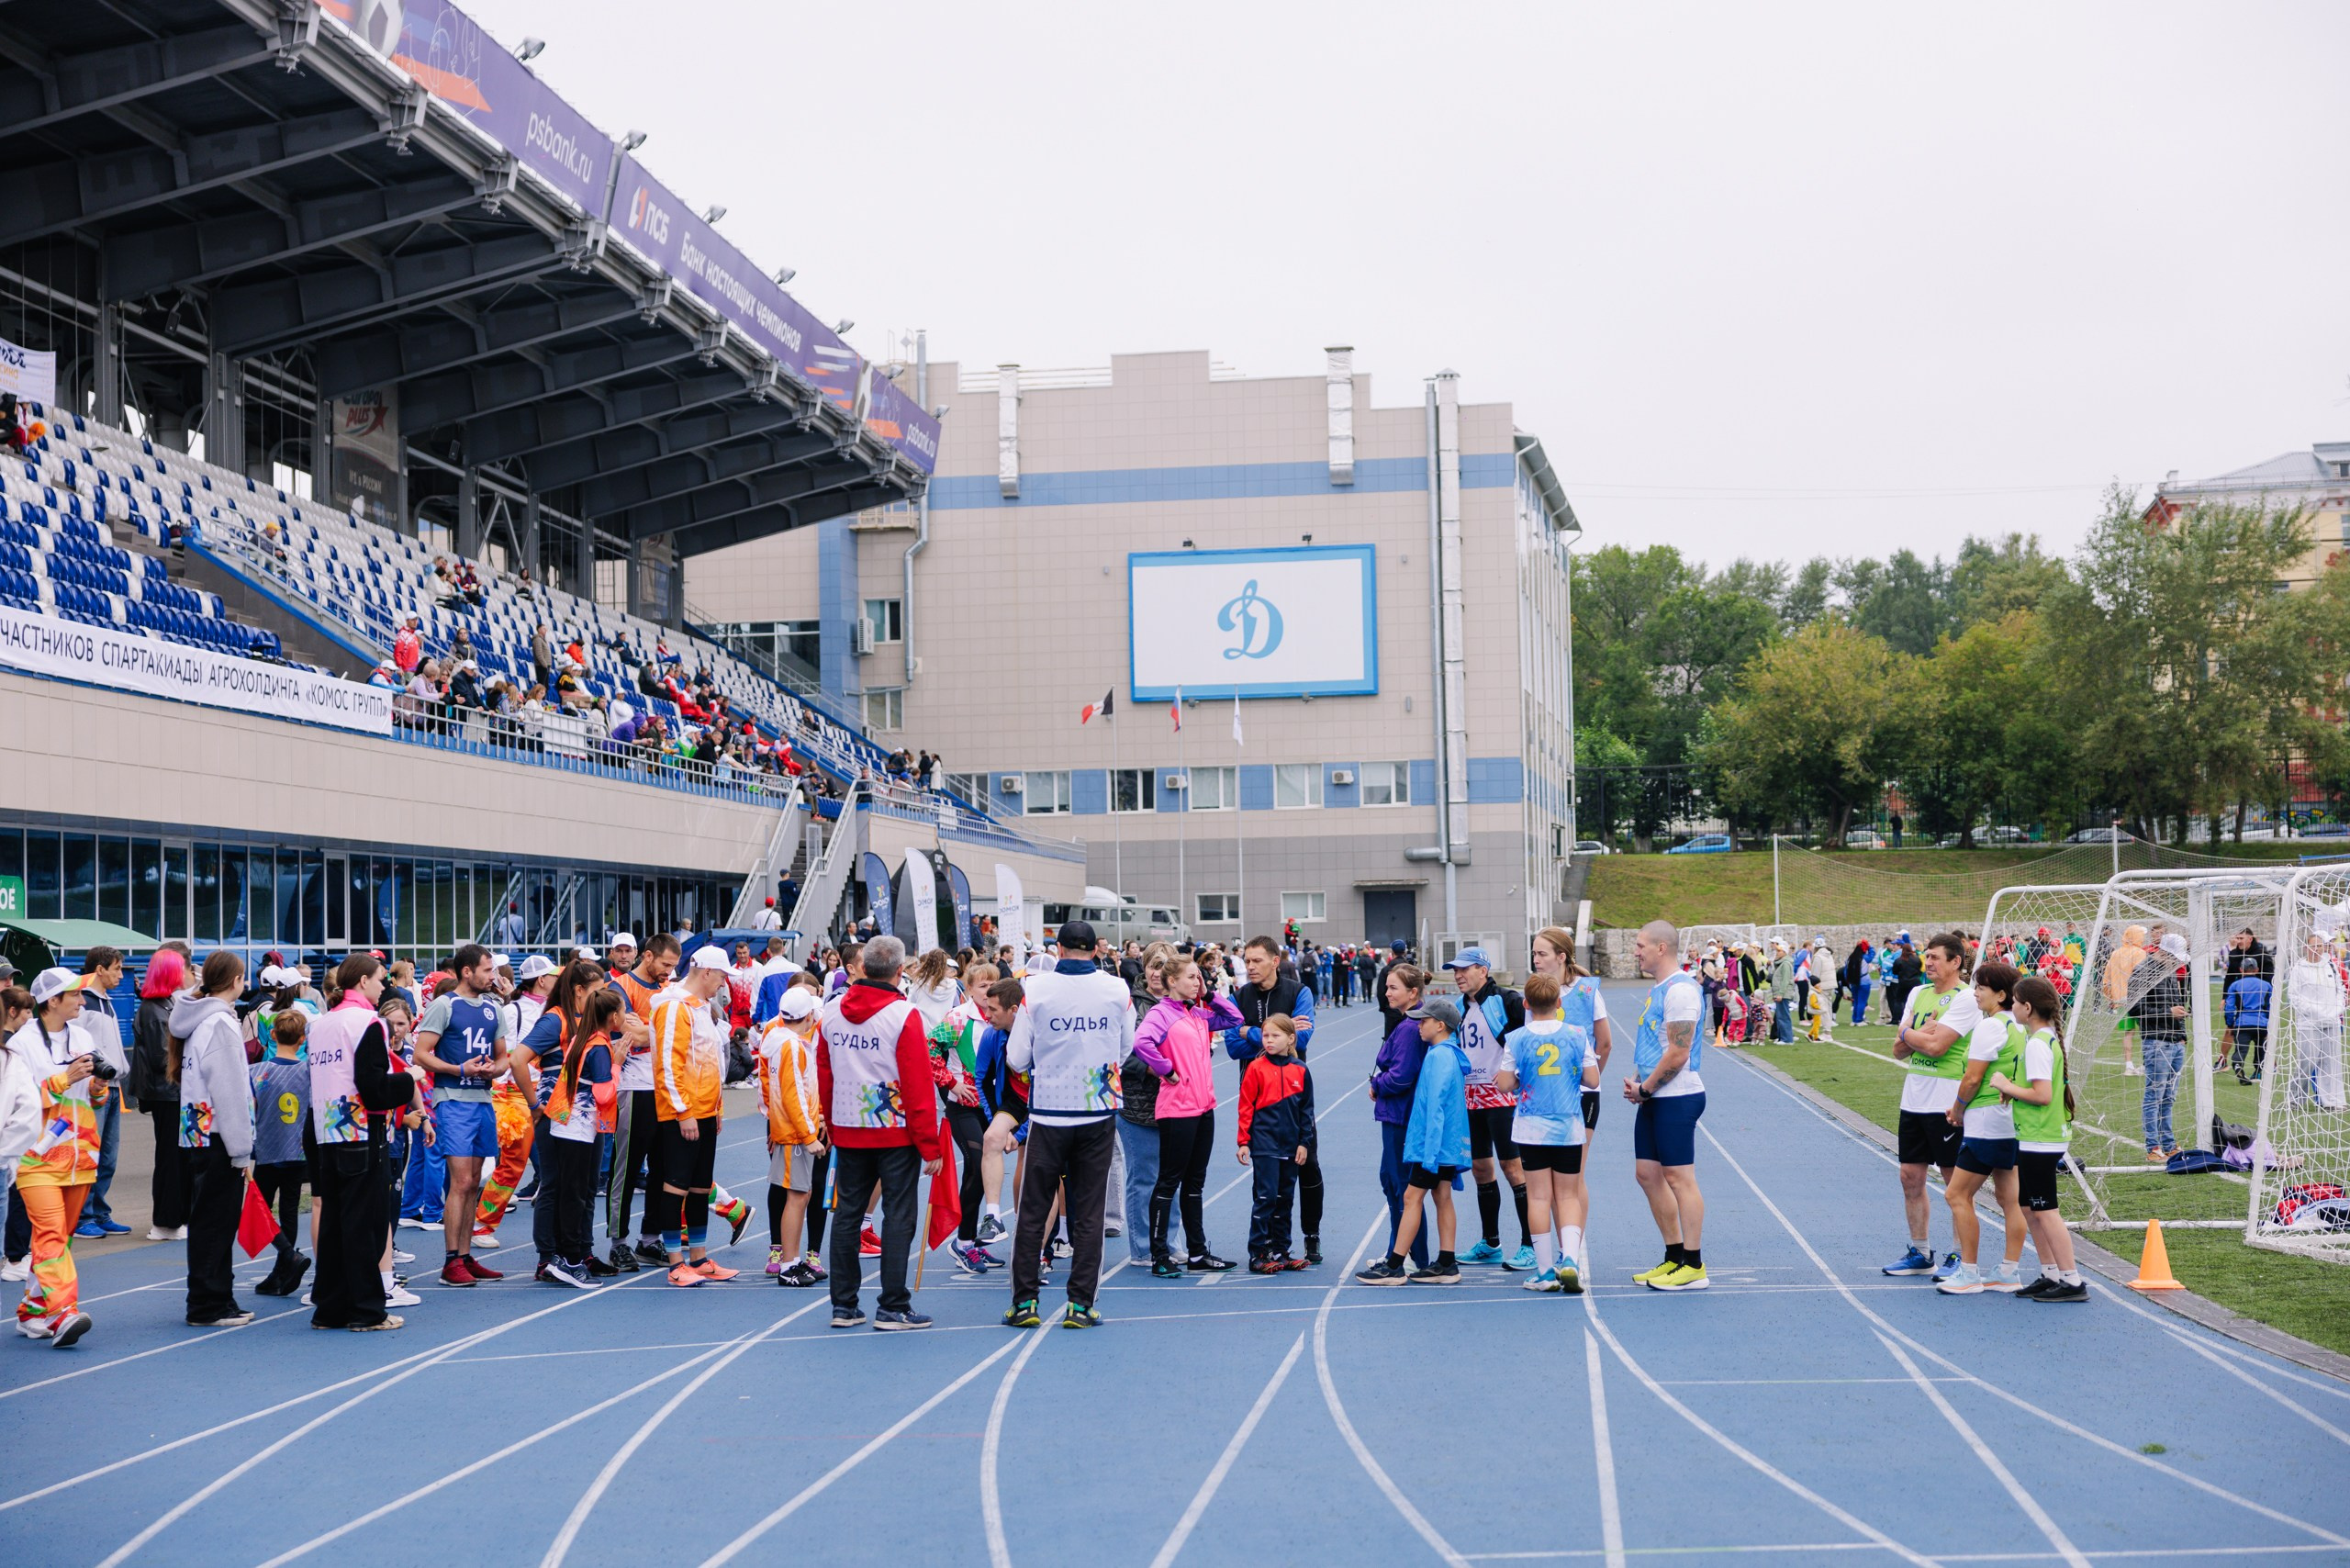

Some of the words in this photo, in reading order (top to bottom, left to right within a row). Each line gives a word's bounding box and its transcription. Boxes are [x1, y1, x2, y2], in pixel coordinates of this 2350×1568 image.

[525, 111, 593, 184] psbank.ru
[643, 201, 670, 245] ПСБ
[680, 230, 707, 276] Банк
[705, 259, 756, 318] настоящих
[755, 301, 801, 353] чемпионов
[906, 422, 936, 458] psbank.ru
[0, 618, 94, 662] ЧАСТНИКОВ
[101, 641, 202, 686] СПАРТАКИАДЫ
[208, 664, 300, 701] АГРОХОЛДИНГА
[306, 683, 349, 711] «КОМОС
[352, 692, 387, 717] ГРУПП»
[463, 1026, 487, 1055] 14
[833, 1032, 879, 1050] СУДЬЯ
[1049, 1016, 1108, 1033] СУДЬЯ
[309, 1049, 342, 1067] СУДЬЯ
[1536, 1043, 1561, 1076] 2
[278, 1092, 299, 1125] 9
